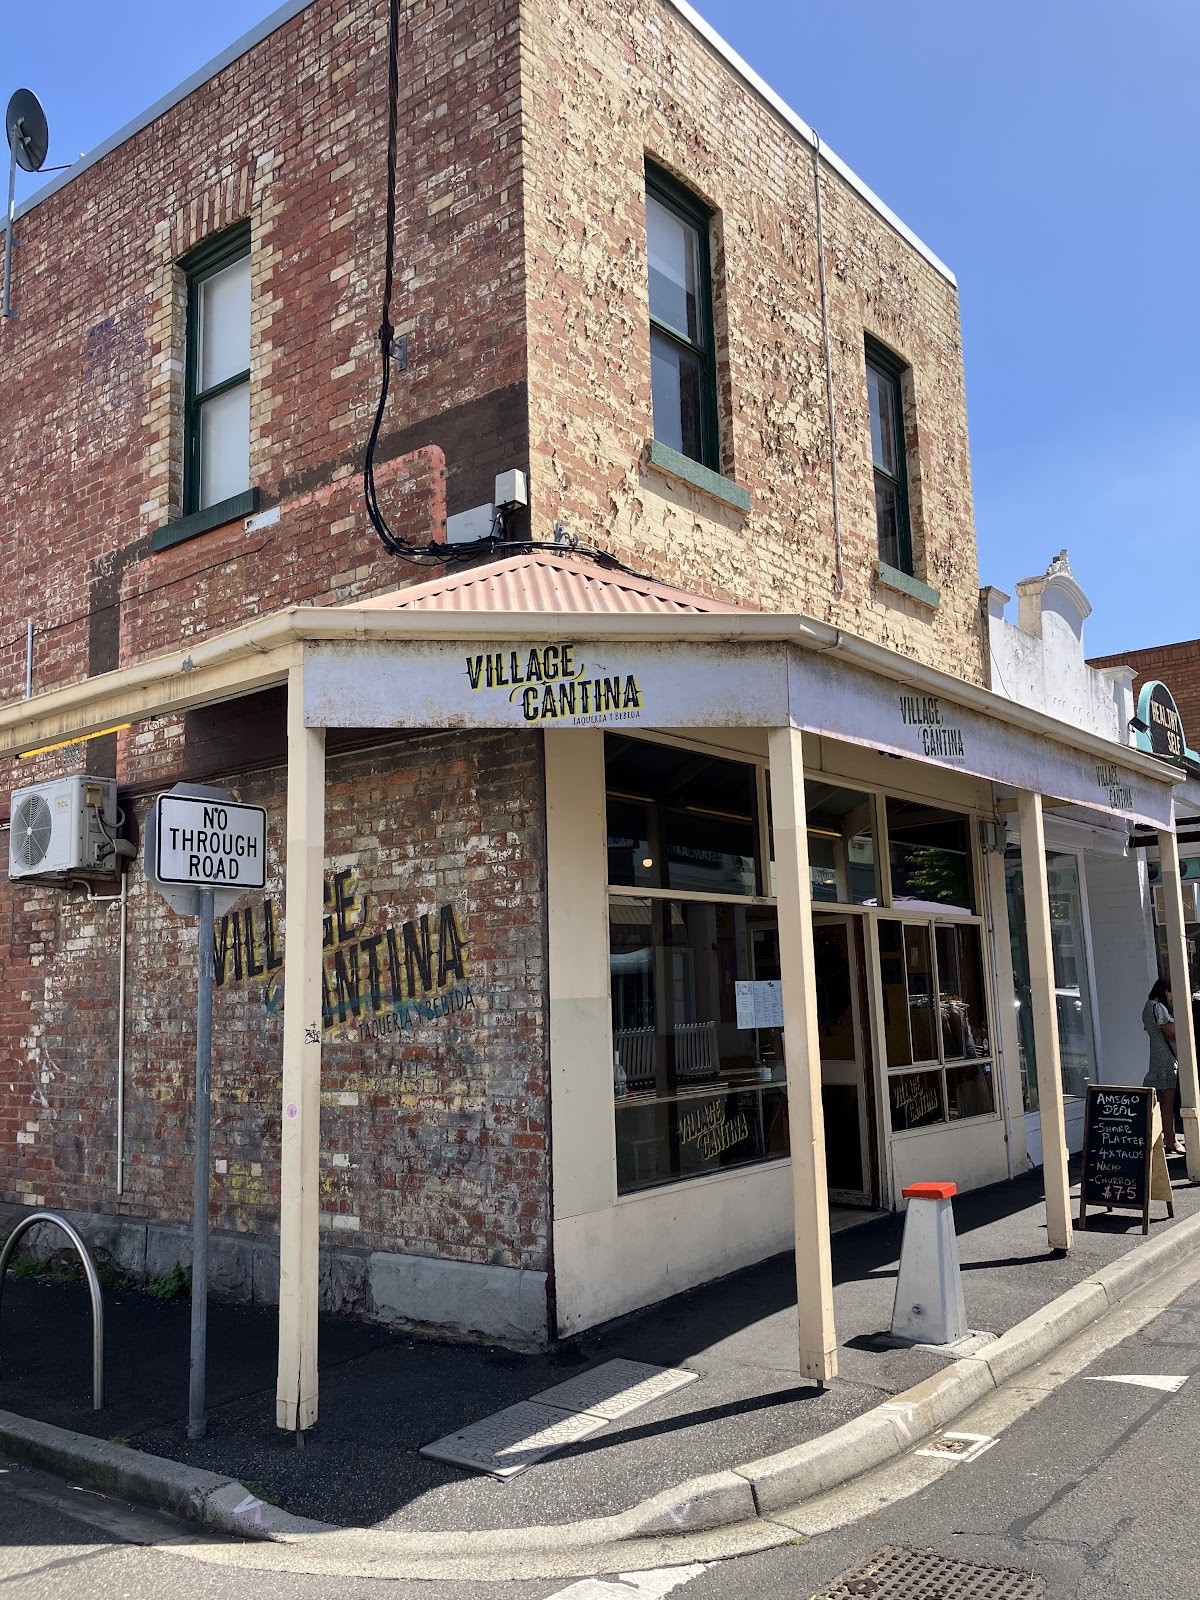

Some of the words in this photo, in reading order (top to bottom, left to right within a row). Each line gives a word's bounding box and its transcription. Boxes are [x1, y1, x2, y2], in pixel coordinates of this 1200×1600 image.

[465, 644, 575, 690] VILLAGE
[520, 674, 641, 721] CANTINA
[615, 710, 640, 721] BEBIDA
[900, 696, 941, 725] VILLAGE
[1150, 700, 1179, 733] HEALTHY
[922, 728, 964, 757] CANTINA
[1167, 731, 1181, 756] SELF
[1095, 765, 1119, 787] VILLAGE
[1108, 788, 1133, 810] CANTINA
[203, 806, 228, 831] NO
[169, 827, 257, 858] THROUGH
[189, 854, 239, 880] ROAD
[359, 1011, 413, 1040] TAQUERIA
[425, 986, 476, 1021] BEBIDA
[1096, 1093, 1140, 1106] AMIGO
[1102, 1105, 1138, 1117] DEAL
[1101, 1133, 1145, 1146] PLATTER
[1101, 1184, 1137, 1201] $75
